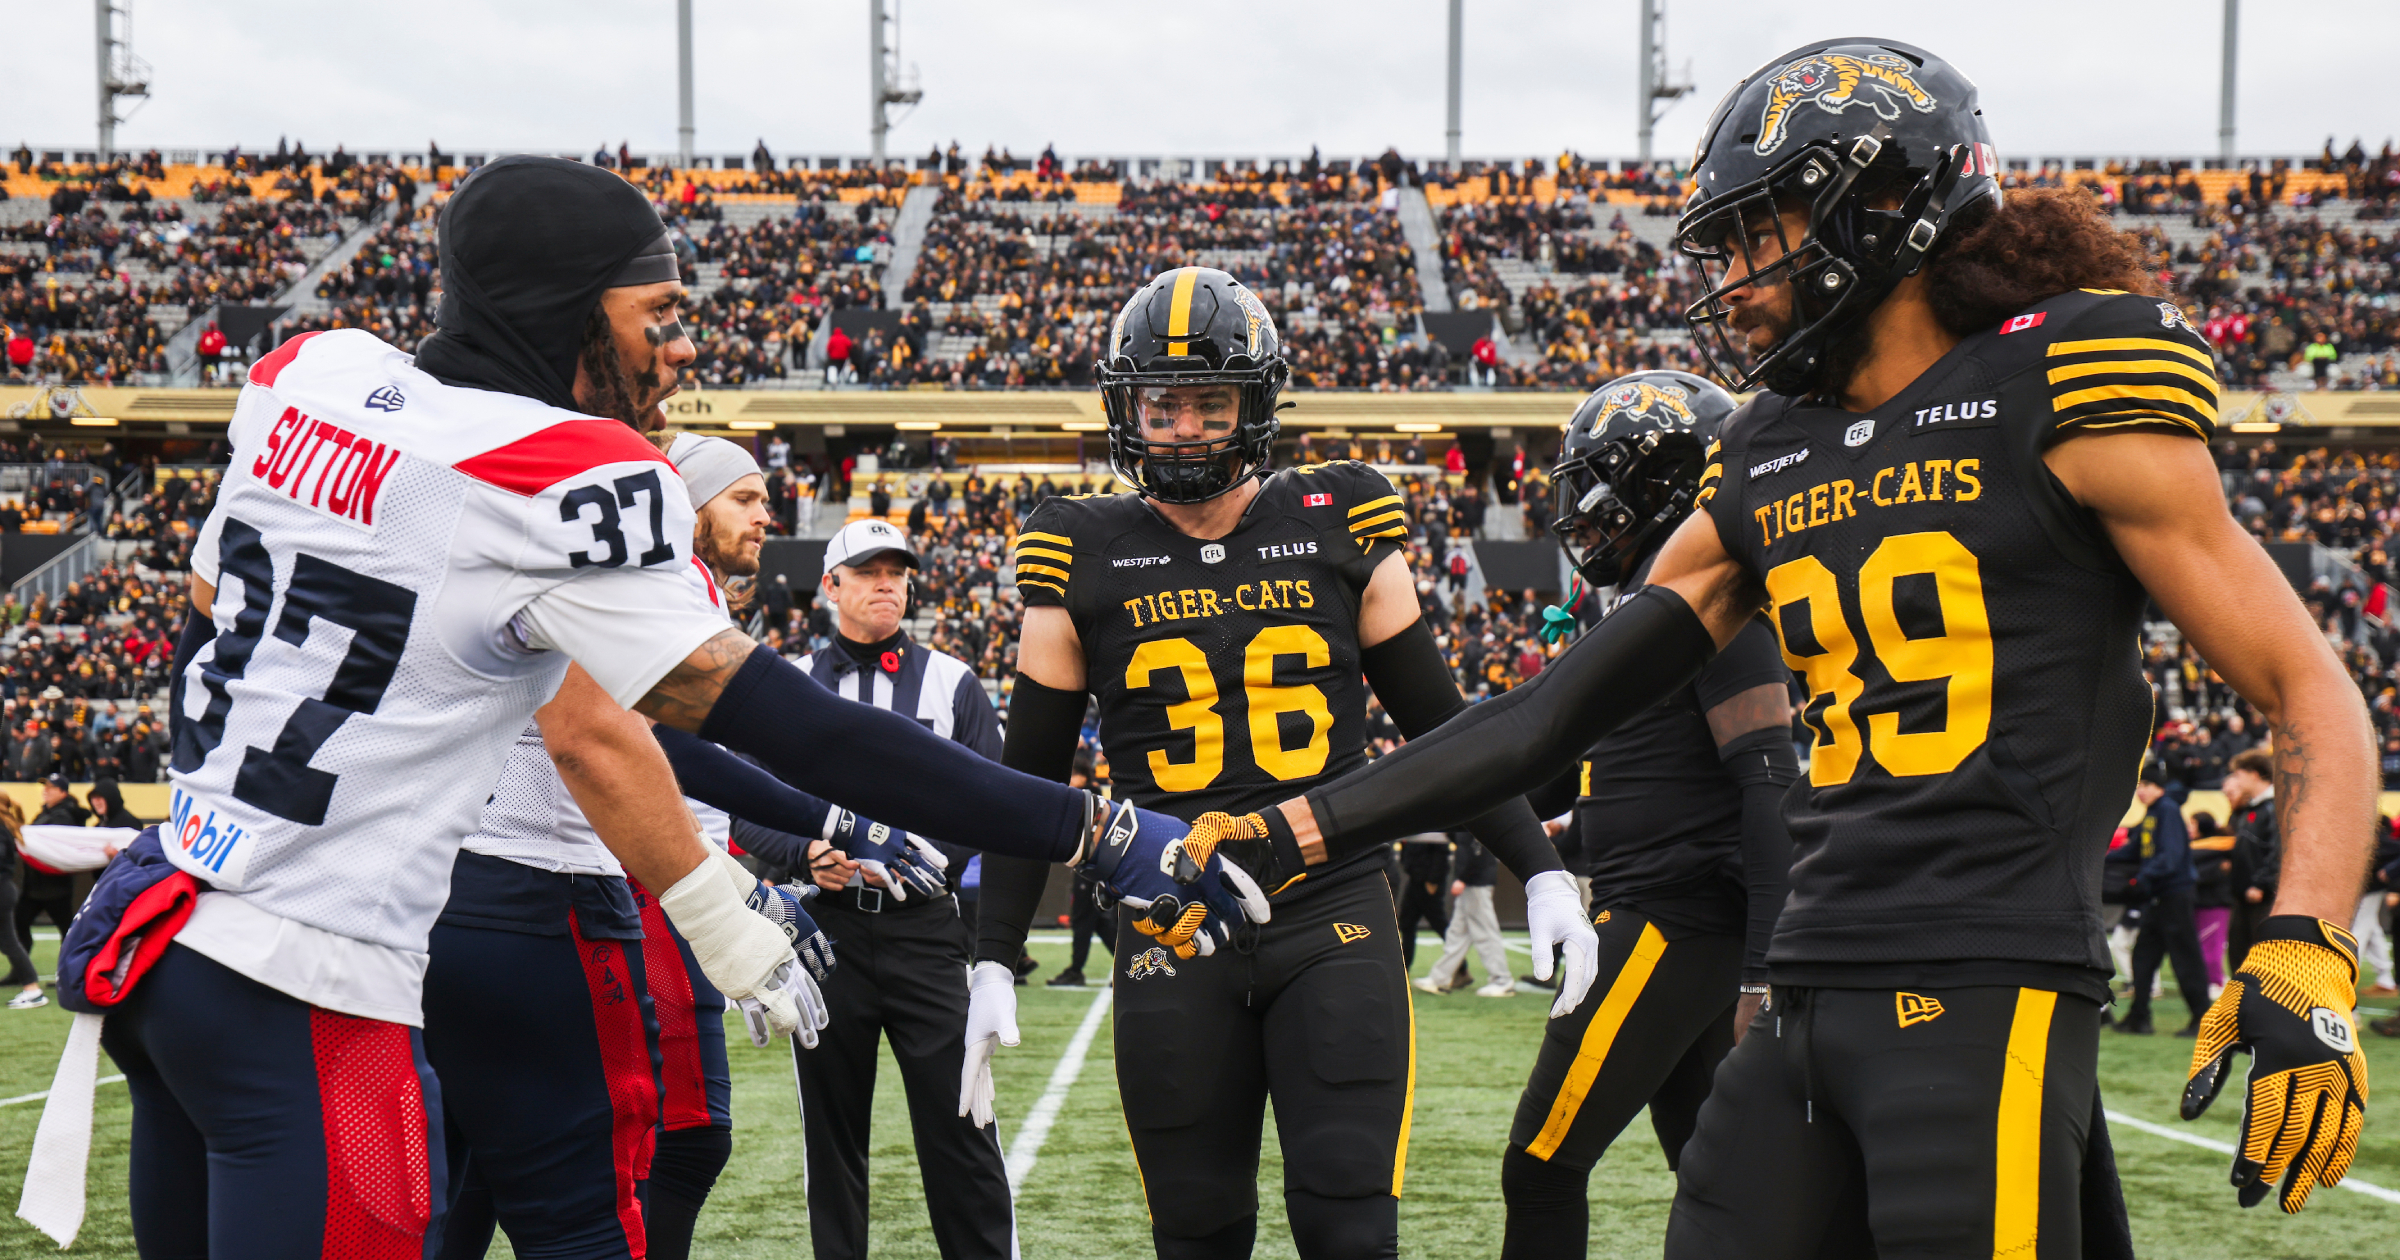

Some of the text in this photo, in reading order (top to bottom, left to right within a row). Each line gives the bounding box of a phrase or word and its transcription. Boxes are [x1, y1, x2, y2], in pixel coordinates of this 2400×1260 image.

[1915, 400, 1998, 427] TELUS
[1849, 427, 1869, 441] CFL
[252, 405, 401, 526] SUTTON
[1749, 452, 1798, 479] WESTJET
[1754, 458, 1983, 547] TIGER-CATS
[559, 469, 676, 569] 37
[871, 525, 890, 535] CFL
[1112, 556, 1158, 569] WESTJET
[1204, 549, 1222, 559] CFL
[1258, 541, 1318, 560] TELUS
[1124, 580, 1315, 628] TIGER-CATS
[1765, 531, 1993, 788] 89
[1125, 625, 1334, 793] 36
[172, 788, 244, 874] Mobil
[2319, 1016, 2348, 1042] CFL
